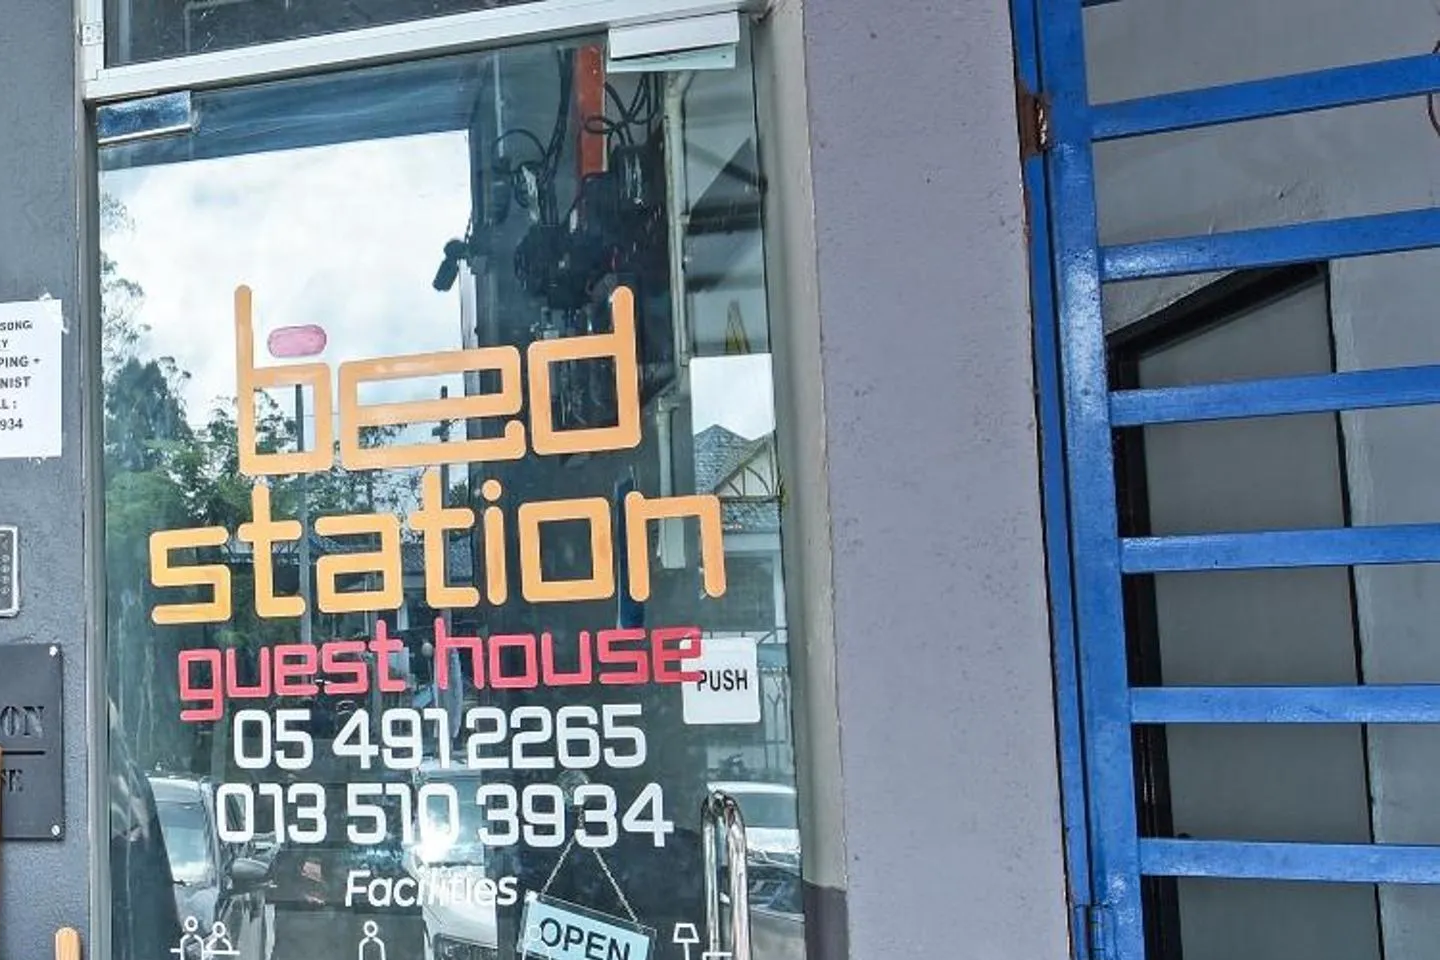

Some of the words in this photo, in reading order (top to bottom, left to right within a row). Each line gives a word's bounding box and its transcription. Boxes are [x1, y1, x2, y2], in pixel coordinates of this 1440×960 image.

[233, 284, 642, 477] bed
[149, 466, 726, 625] station
[178, 619, 407, 722] guest
[434, 617, 704, 691] house
[696, 669, 748, 692] PUSH
[232, 708, 314, 771] 05
[331, 704, 647, 771] 4912265
[216, 783, 327, 845] 013
[346, 783, 462, 845] 510
[474, 783, 675, 849] 3934
[344, 866, 518, 908] Facilities
